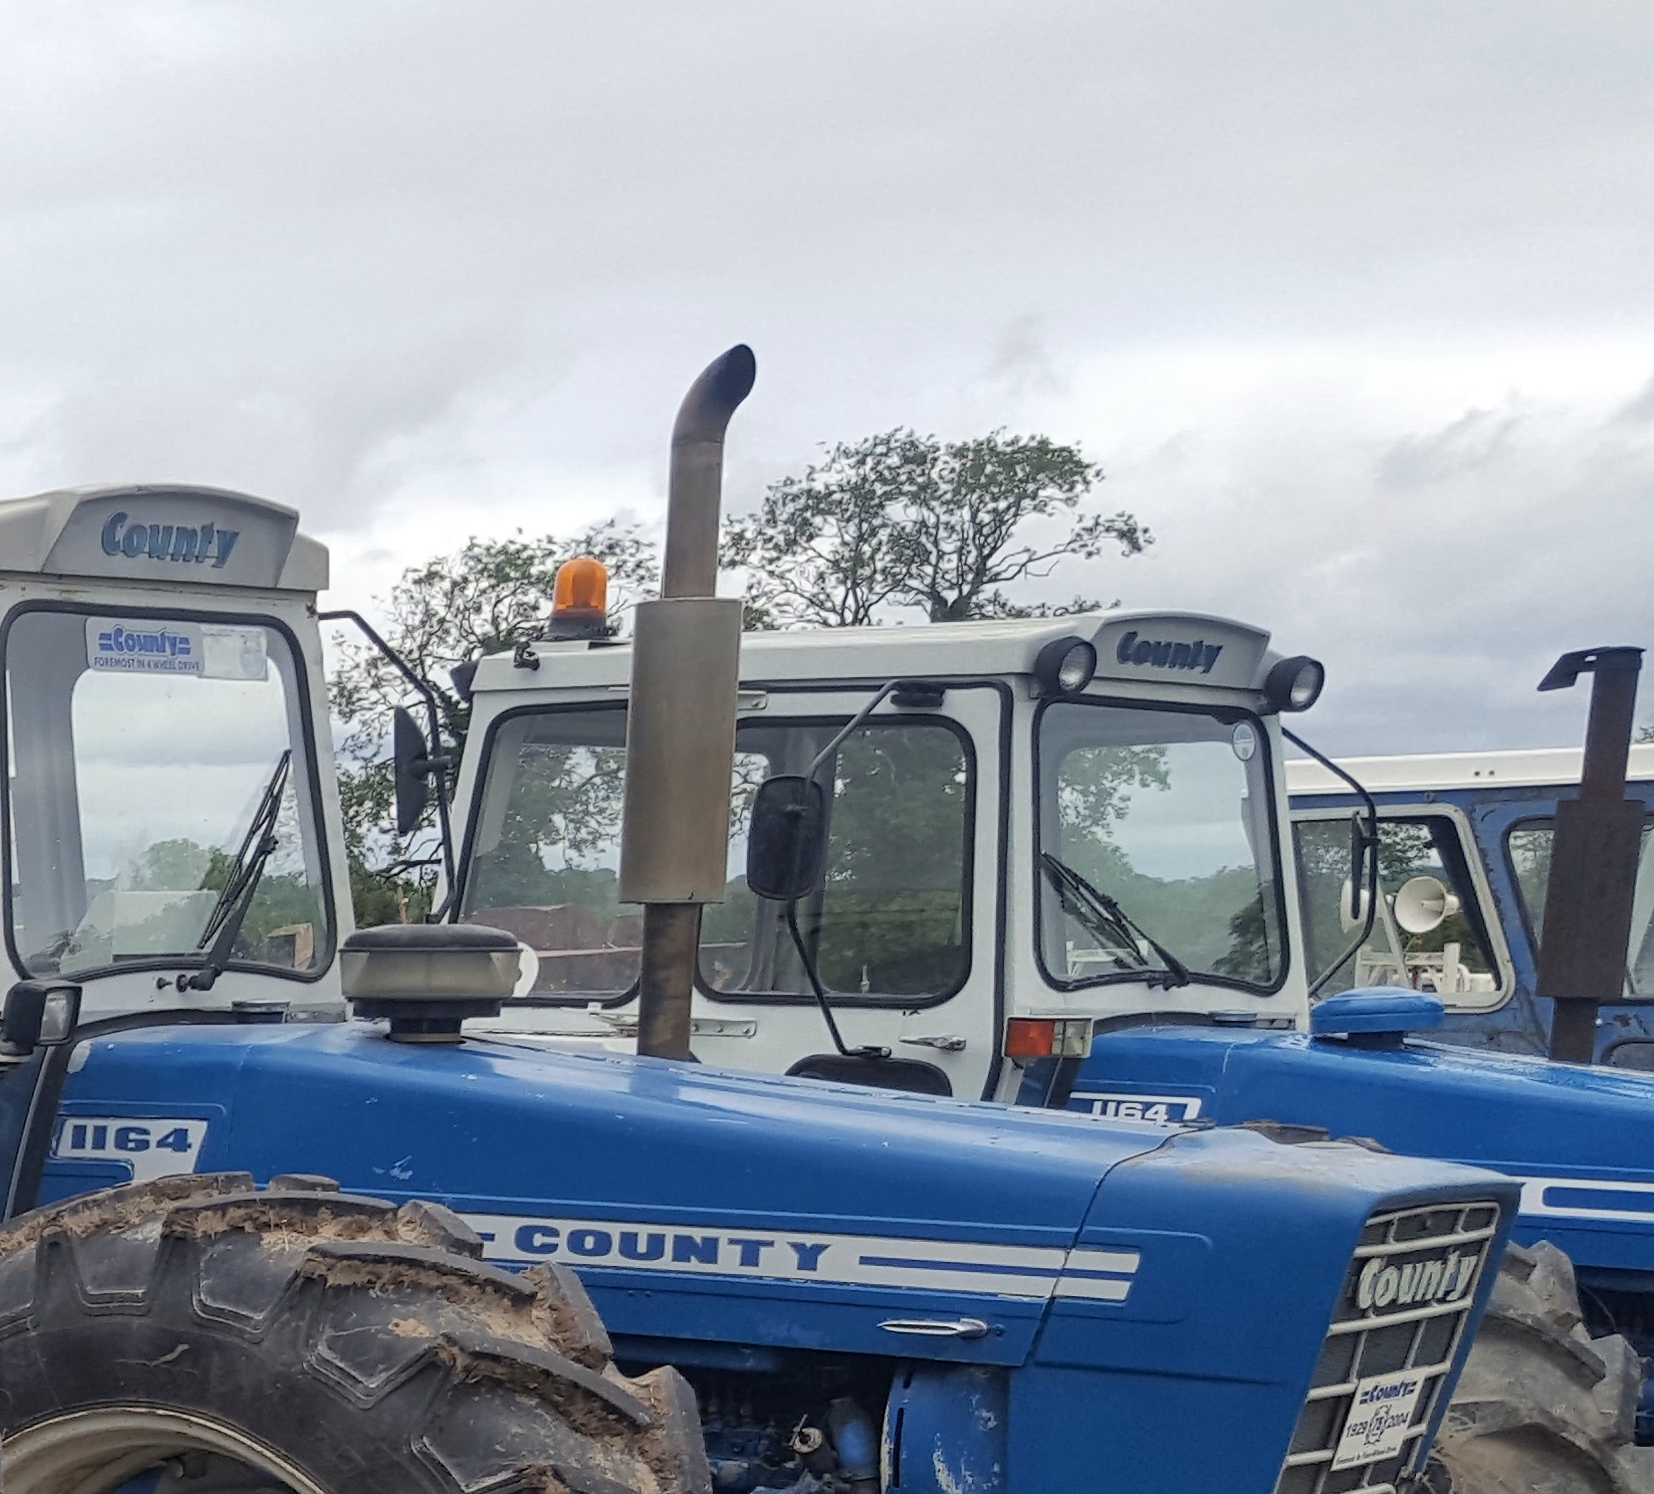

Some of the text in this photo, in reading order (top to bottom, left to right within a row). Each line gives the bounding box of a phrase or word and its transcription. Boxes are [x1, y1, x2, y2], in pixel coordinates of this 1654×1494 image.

[101, 511, 241, 569] County
[112, 624, 180, 657] County
[1116, 630, 1224, 675] County
[94, 656, 134, 669] FOREMOST
[1092, 1100, 1168, 1127] 1164
[71, 1124, 193, 1153] 1164
[515, 1224, 832, 1272] COUNTY
[1358, 1250, 1479, 1310] County
